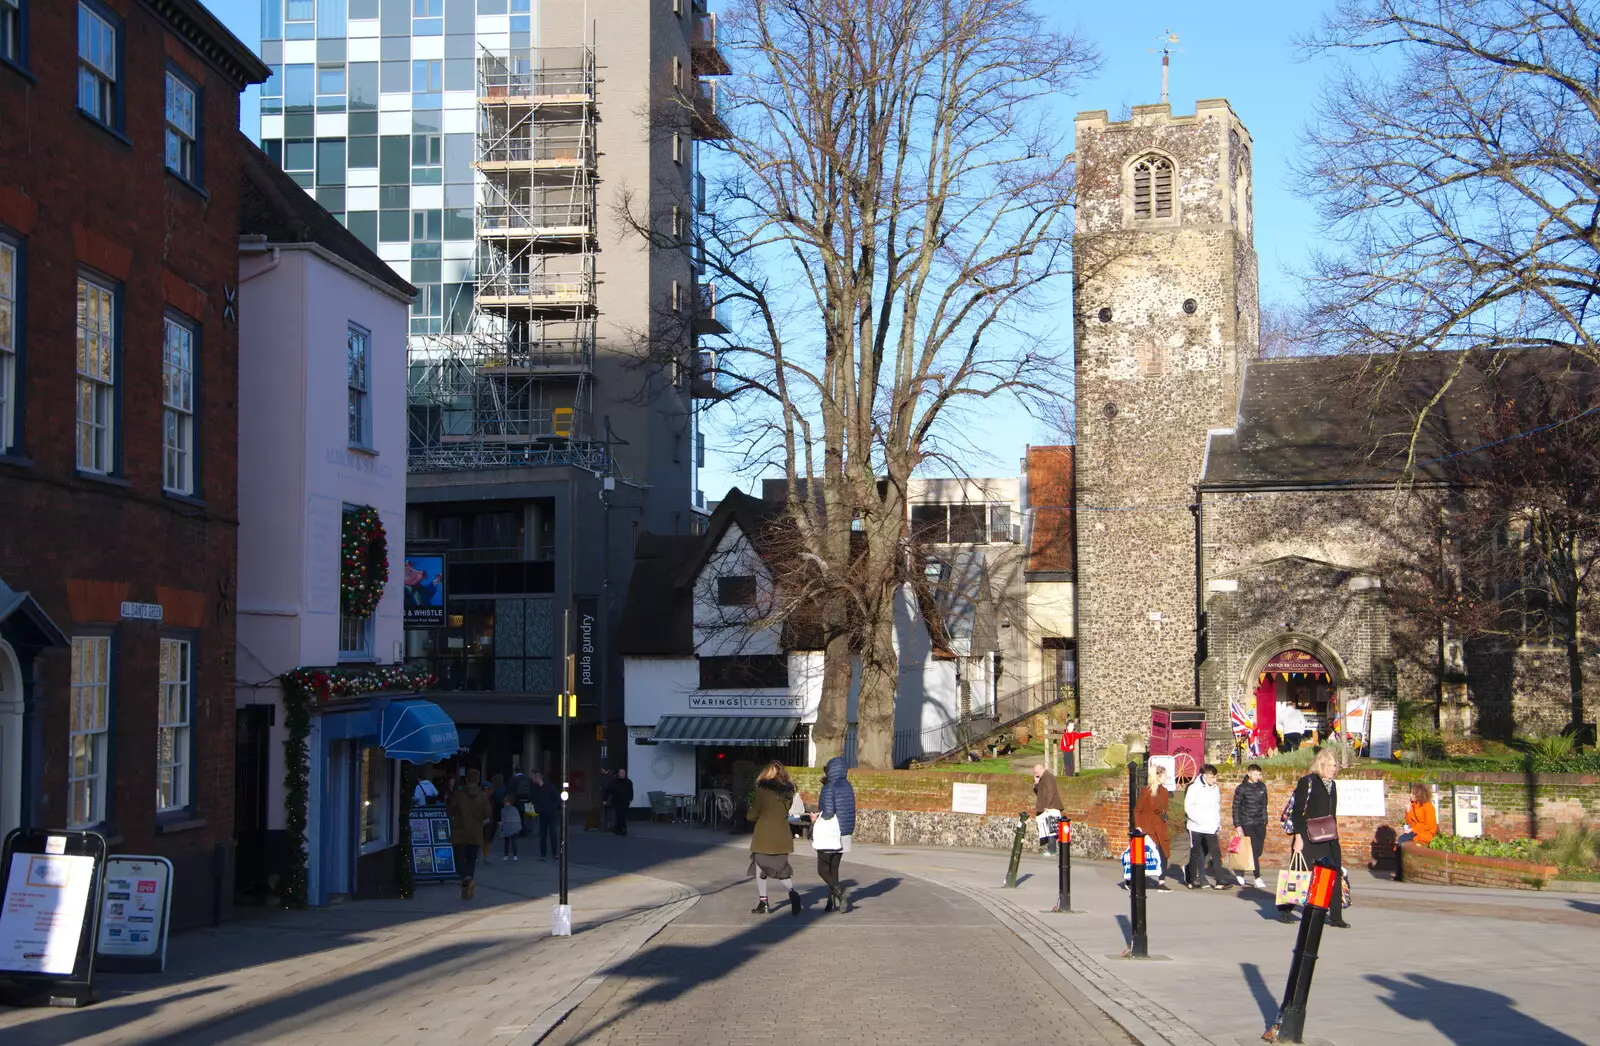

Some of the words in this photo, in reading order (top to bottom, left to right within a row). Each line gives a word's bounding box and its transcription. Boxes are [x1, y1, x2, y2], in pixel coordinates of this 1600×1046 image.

[122, 602, 131, 616] ALL
[131, 603, 148, 617] SAINTS
[148, 604, 162, 618] GREEN
[414, 609, 443, 617] WHISTLE
[580, 614, 594, 653] gundry
[580, 656, 593, 685] paula
[743, 698, 800, 706] LIFESTORE
